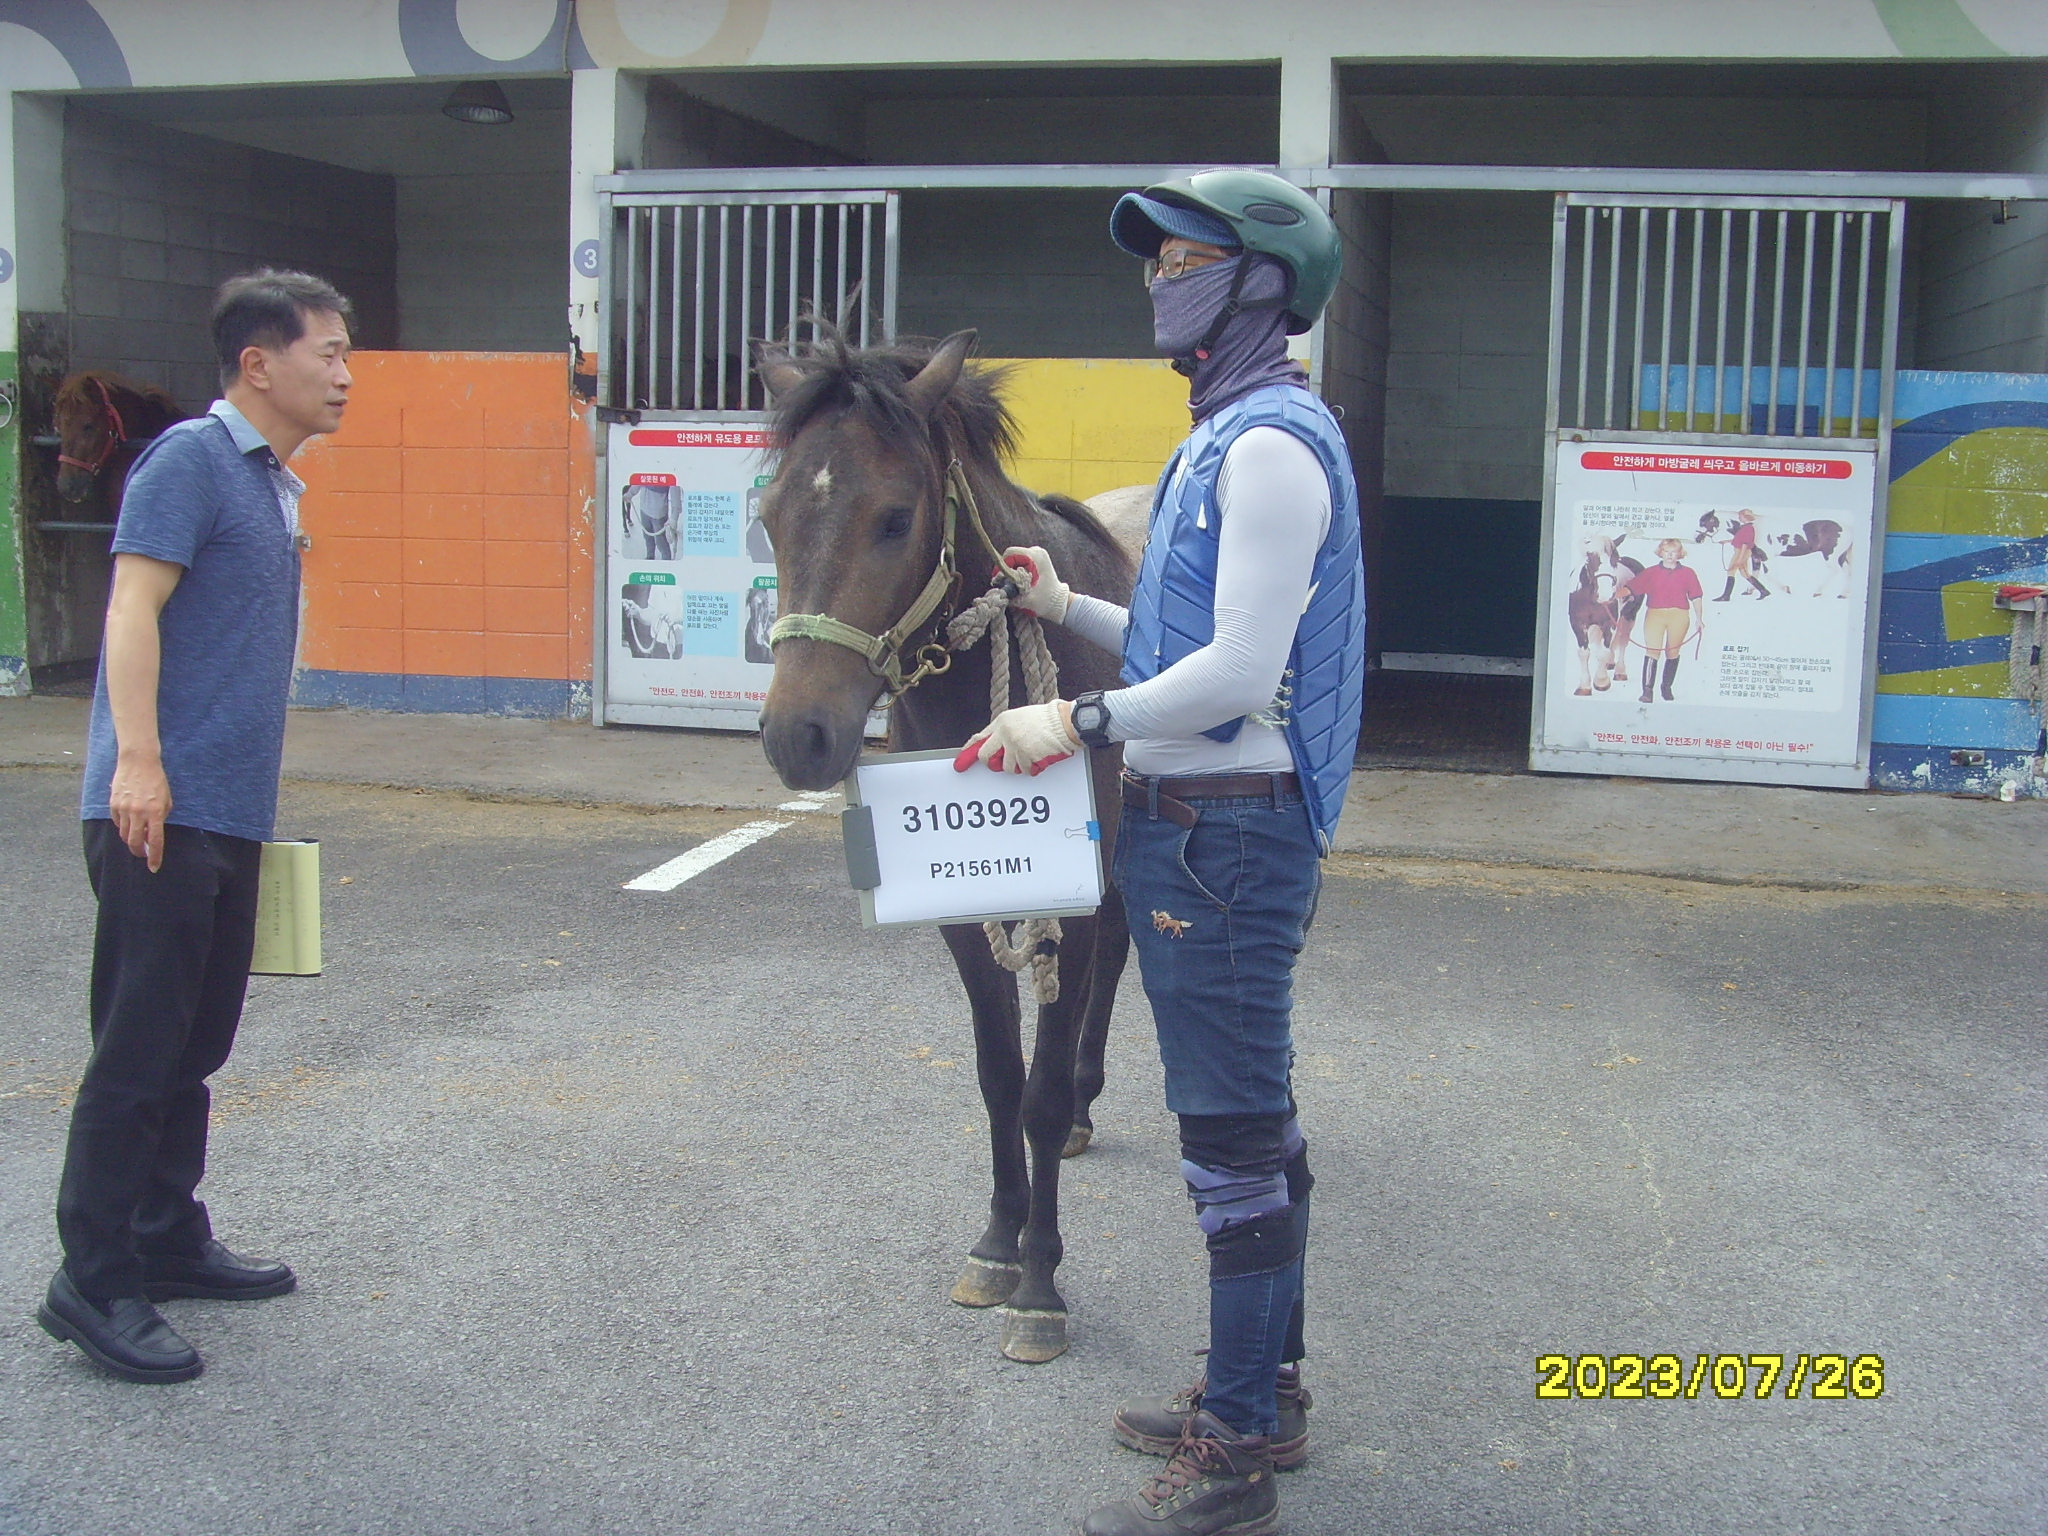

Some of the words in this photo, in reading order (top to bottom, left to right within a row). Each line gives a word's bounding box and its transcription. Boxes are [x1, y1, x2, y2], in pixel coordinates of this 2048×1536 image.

[584, 248, 597, 269] 3
[677, 433, 712, 444] 안전하게
[715, 434, 741, 444] 유도용
[1613, 455, 1655, 467] 안전하게
[1658, 456, 1700, 470] 마방굴레
[1703, 458, 1736, 471] 씌우고
[1739, 459, 1781, 473] 올바르게
[1784, 461, 1827, 475] 이동하기
[640, 475, 658, 484] 잘못된
[639, 574, 652, 583] 손의
[654, 575, 666, 583] 위치
[710, 689, 741, 700] 안전조끼
[1664, 736, 1701, 747] 안전조끼
[1705, 738, 1731, 748] 착용은
[1735, 740, 1762, 750] 선택이
[1766, 741, 1784, 752] 아닌
[902, 795, 1051, 833] 3103929
[930, 856, 1033, 878] P21561M1
